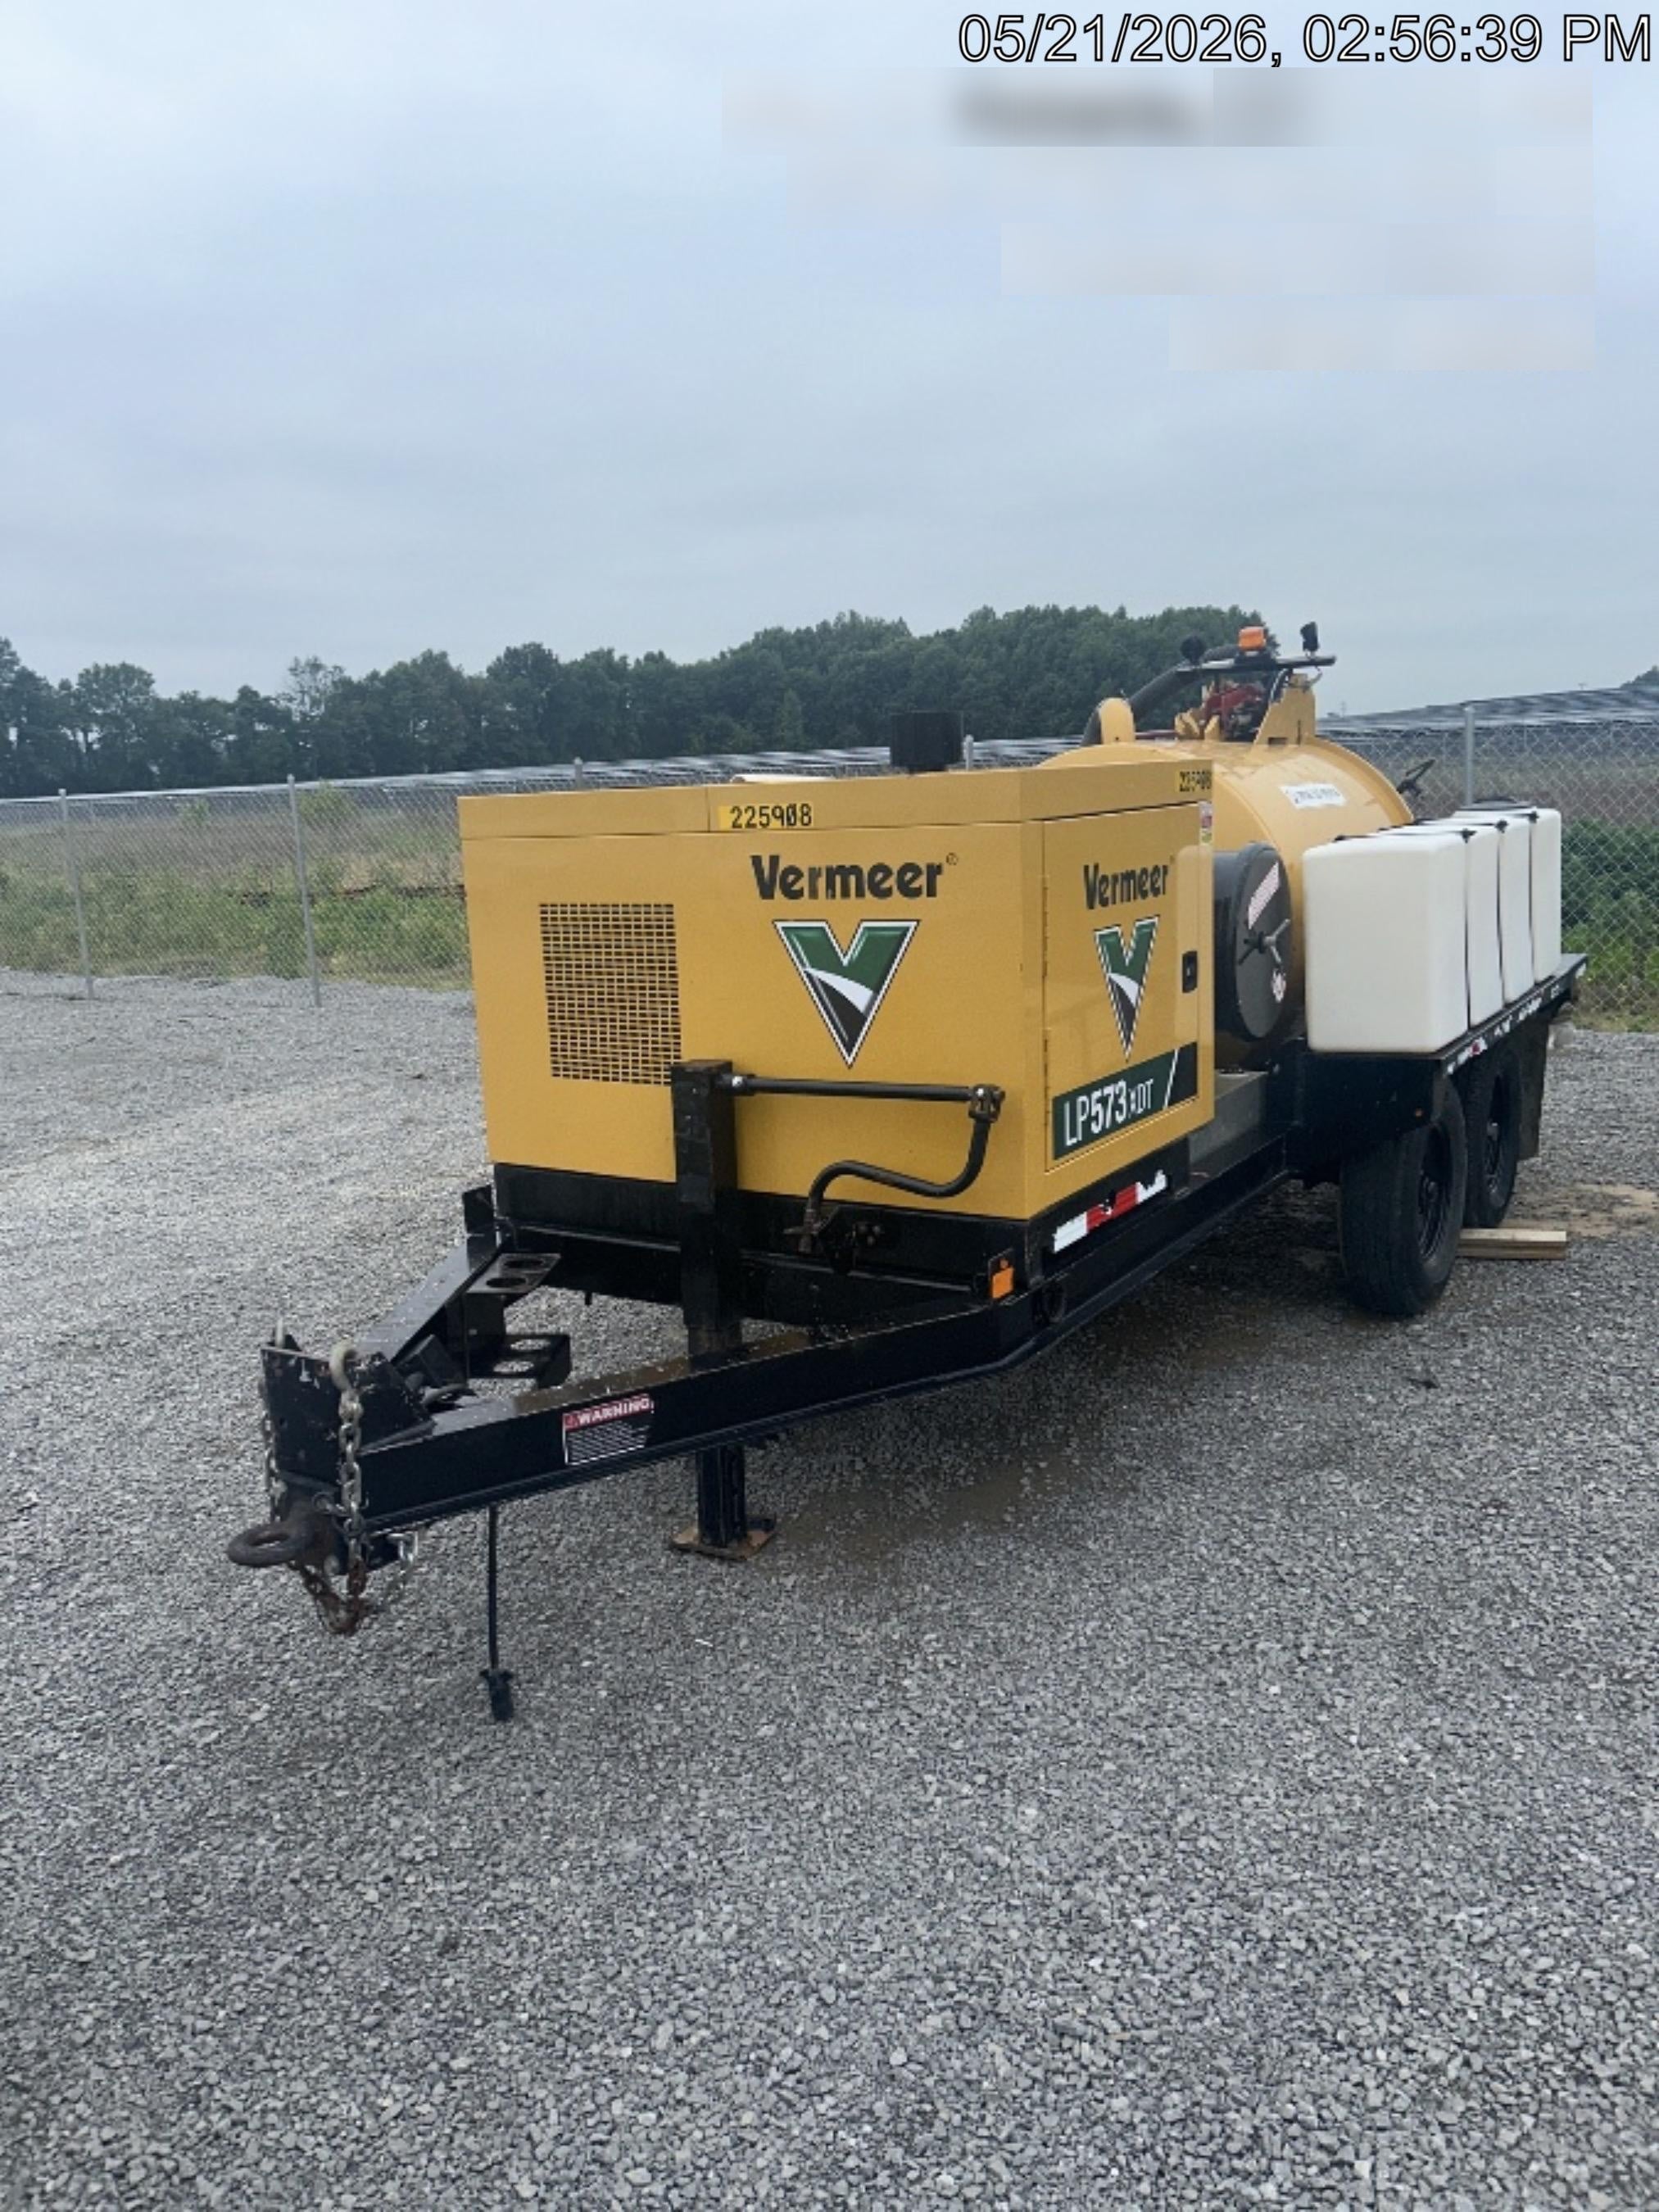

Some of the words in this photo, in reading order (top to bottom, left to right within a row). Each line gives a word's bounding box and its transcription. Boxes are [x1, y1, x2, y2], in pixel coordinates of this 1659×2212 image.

[729, 803, 812, 829] 225908
[750, 854, 943, 900] Vermeer
[1083, 863, 1168, 909] Vermeer
[578, 1396, 650, 1426] WARNING
